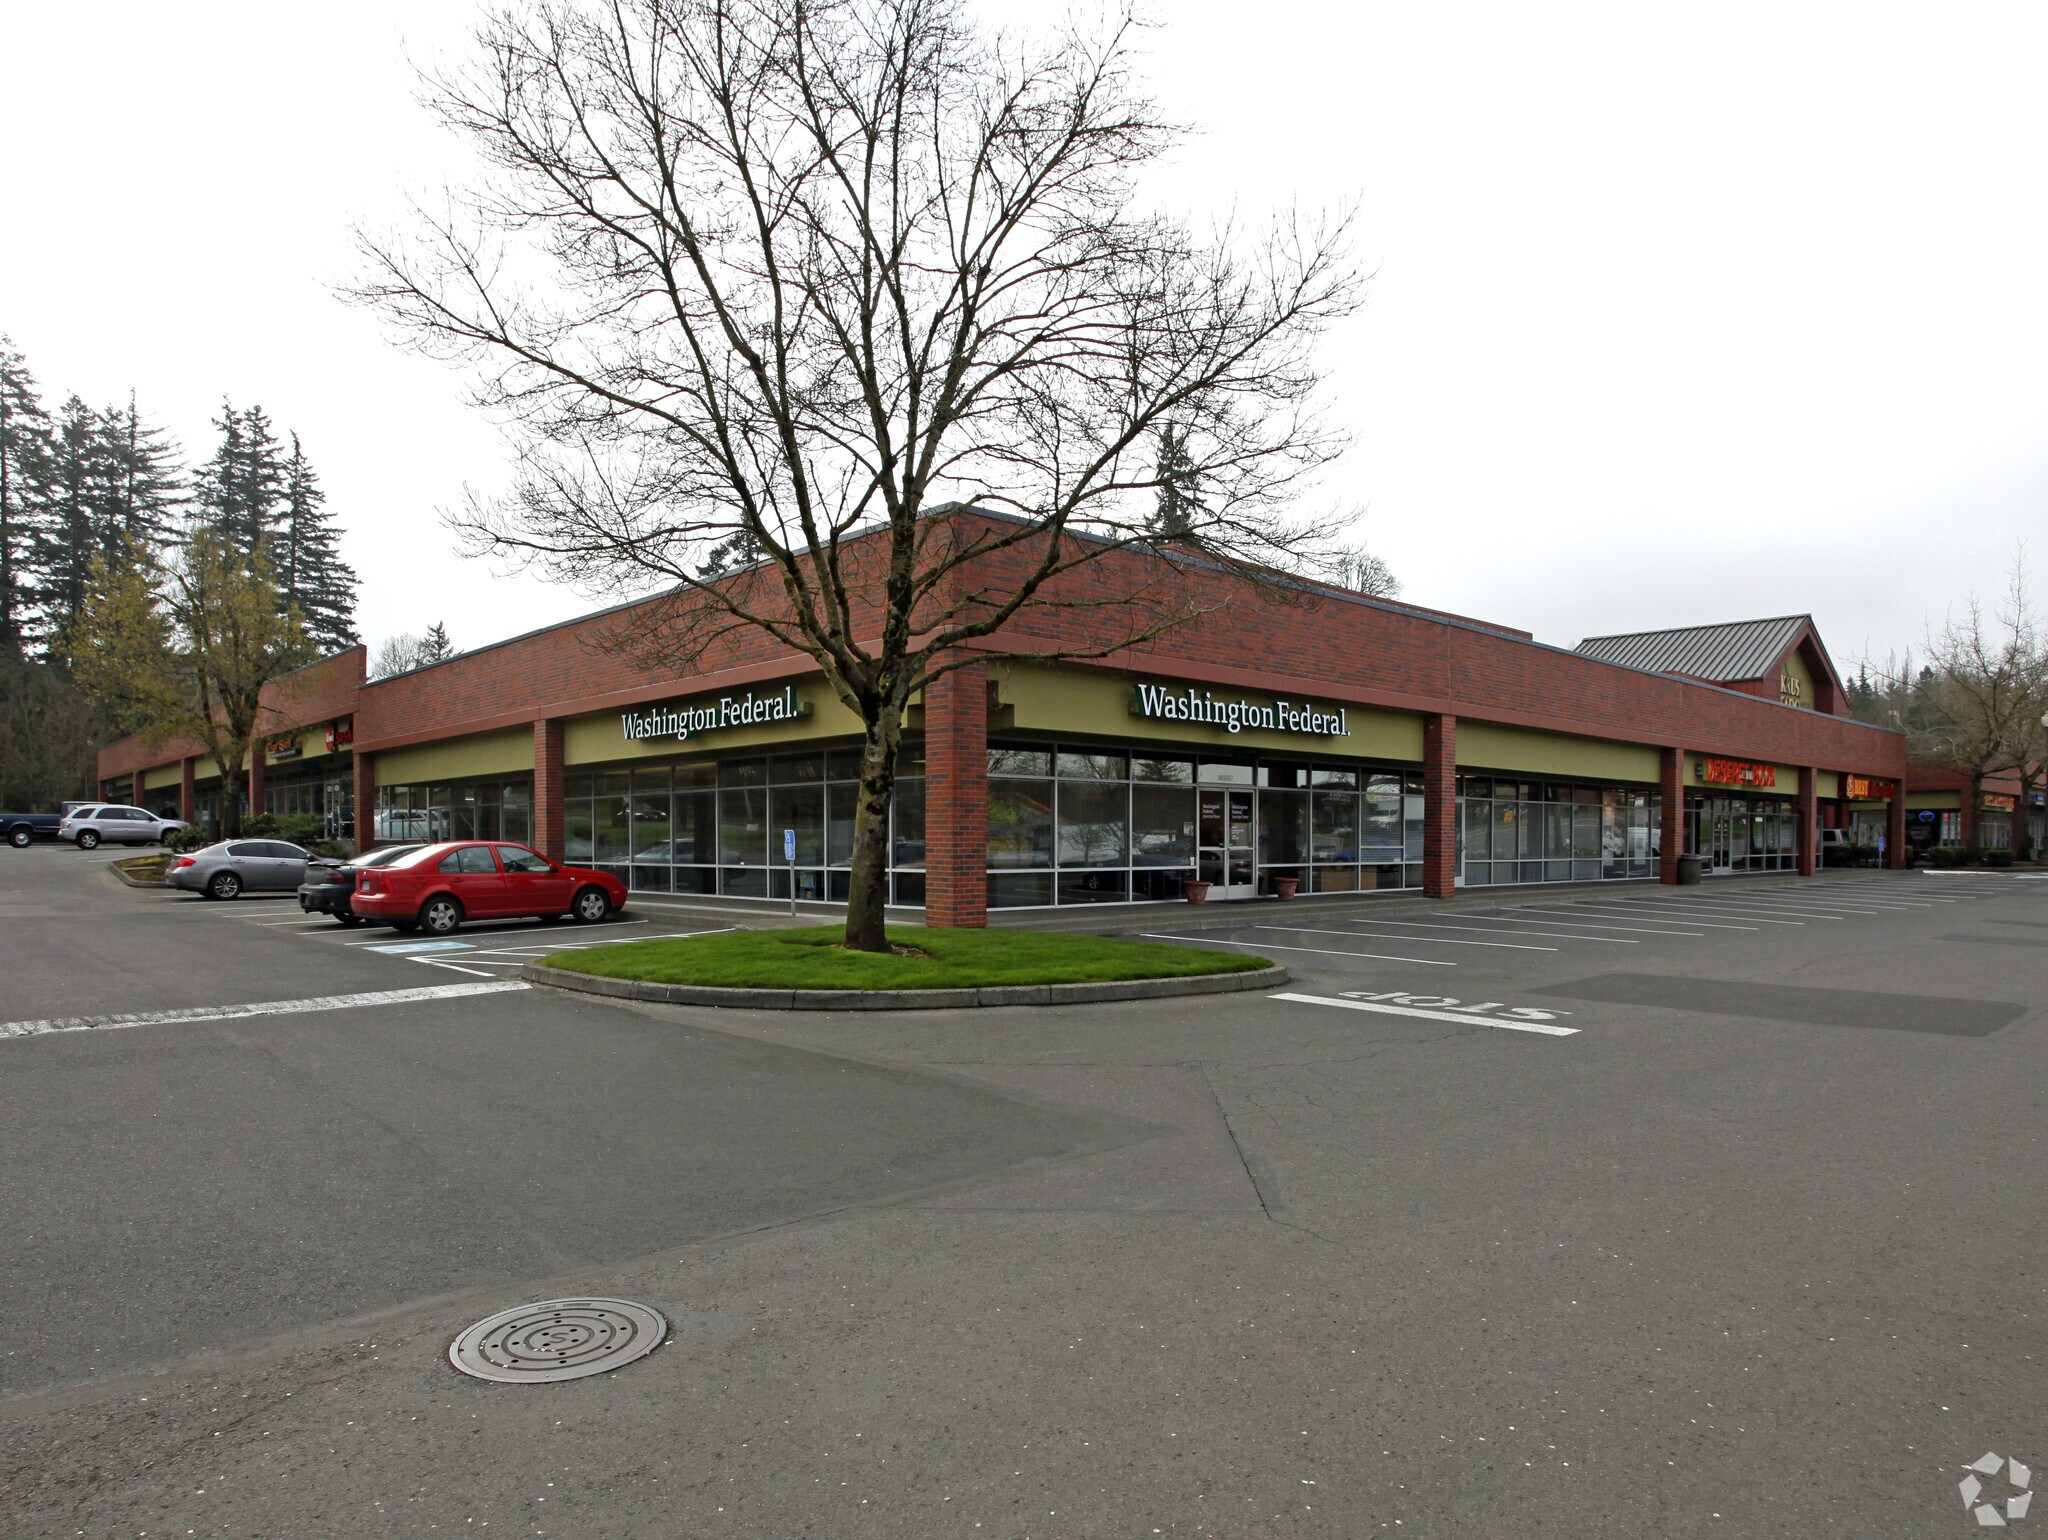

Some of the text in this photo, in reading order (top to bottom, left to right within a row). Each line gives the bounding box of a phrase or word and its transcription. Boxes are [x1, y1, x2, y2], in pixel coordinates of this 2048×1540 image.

[622, 686, 798, 740] Washington Federal.
[1138, 684, 1351, 737] Washington Federal.
[1707, 758, 1776, 786] DESERET BOOK
[1338, 992, 1574, 1019] STOP
